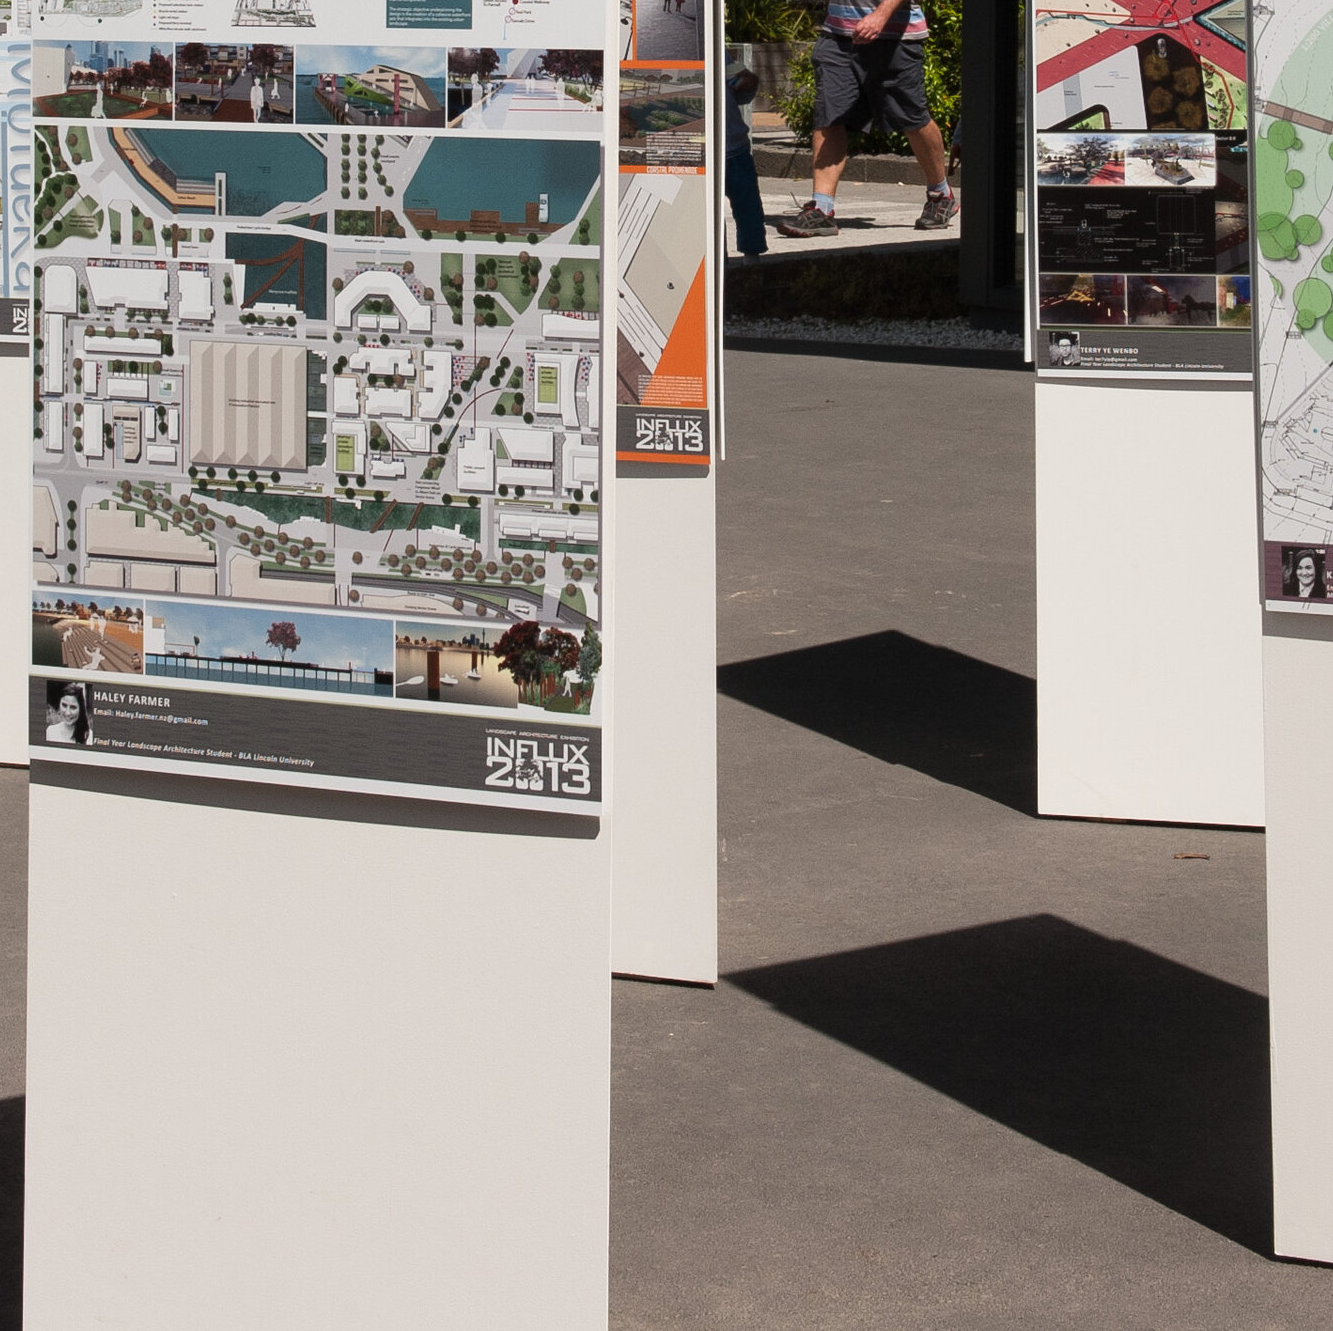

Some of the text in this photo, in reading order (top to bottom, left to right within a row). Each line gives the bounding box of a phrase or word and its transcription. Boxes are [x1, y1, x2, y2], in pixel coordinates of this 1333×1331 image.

[1080, 346, 1102, 354] TERRY
[1112, 347, 1139, 355] WENBO
[635, 418, 703, 434] INFLUX
[93, 691, 171, 708] HALEY FARMER
[93, 708, 115, 717] Email:
[93, 737, 315, 768] Final Year Landscape Architecture Student BLA Lincoln University
[487, 736, 590, 766] INFLUX
